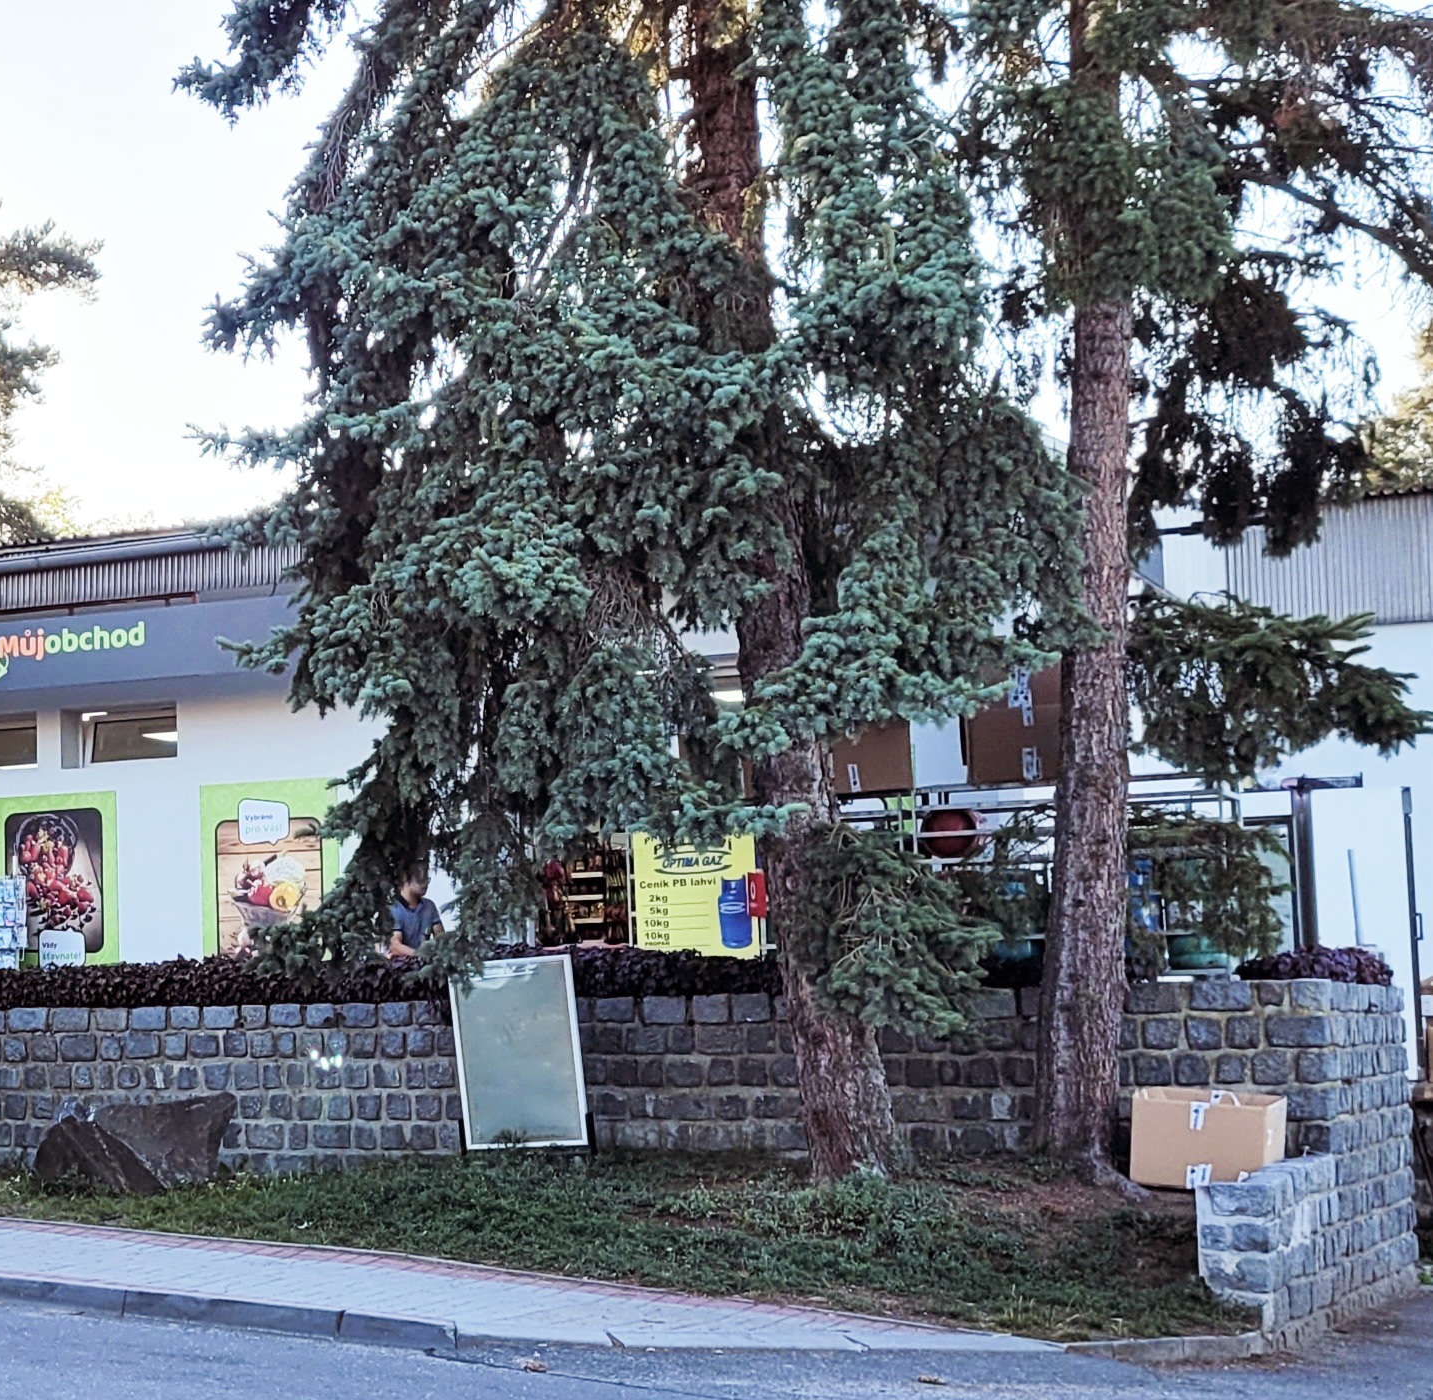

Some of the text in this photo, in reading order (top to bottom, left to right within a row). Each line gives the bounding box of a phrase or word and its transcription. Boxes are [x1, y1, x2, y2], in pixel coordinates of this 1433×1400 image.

[245, 826, 261, 835] pro
[702, 855, 724, 866] GAZ
[673, 878, 687, 887] PB
[649, 894, 668, 903] 2kg
[649, 907, 669, 916] 5kg
[644, 919, 670, 928] 10kg
[644, 931, 670, 941] 10kg
